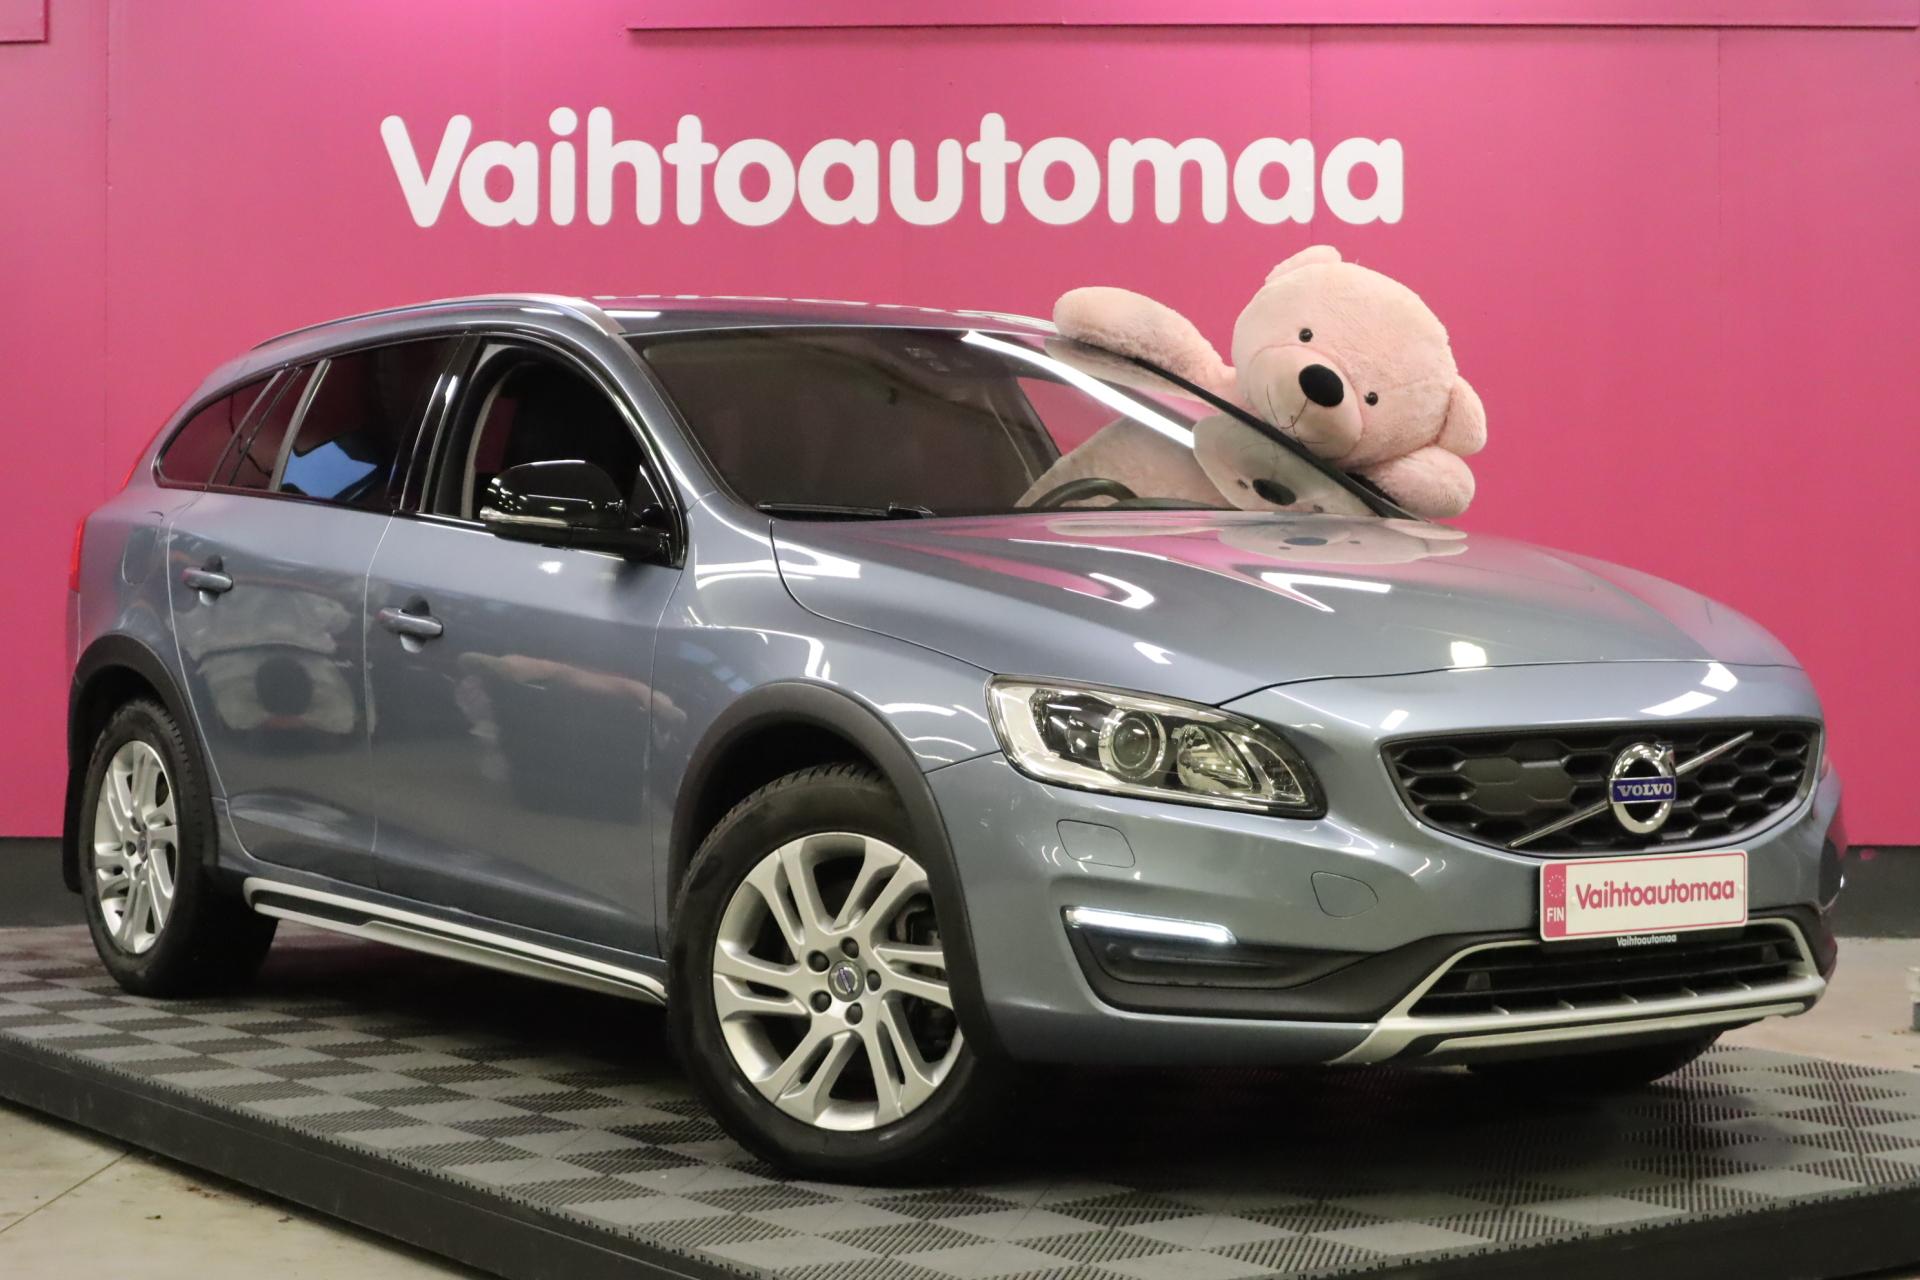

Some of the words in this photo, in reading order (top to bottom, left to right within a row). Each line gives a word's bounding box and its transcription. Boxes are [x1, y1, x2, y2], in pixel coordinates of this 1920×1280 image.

[380, 106, 1404, 228] Vaihtoautomaa
[1616, 783, 1673, 797] VOLVO
[1575, 879, 1735, 910] Vaihtoautomaa
[1546, 907, 1565, 923] FIN
[1616, 934, 1677, 948] Vaihtoautomaa
